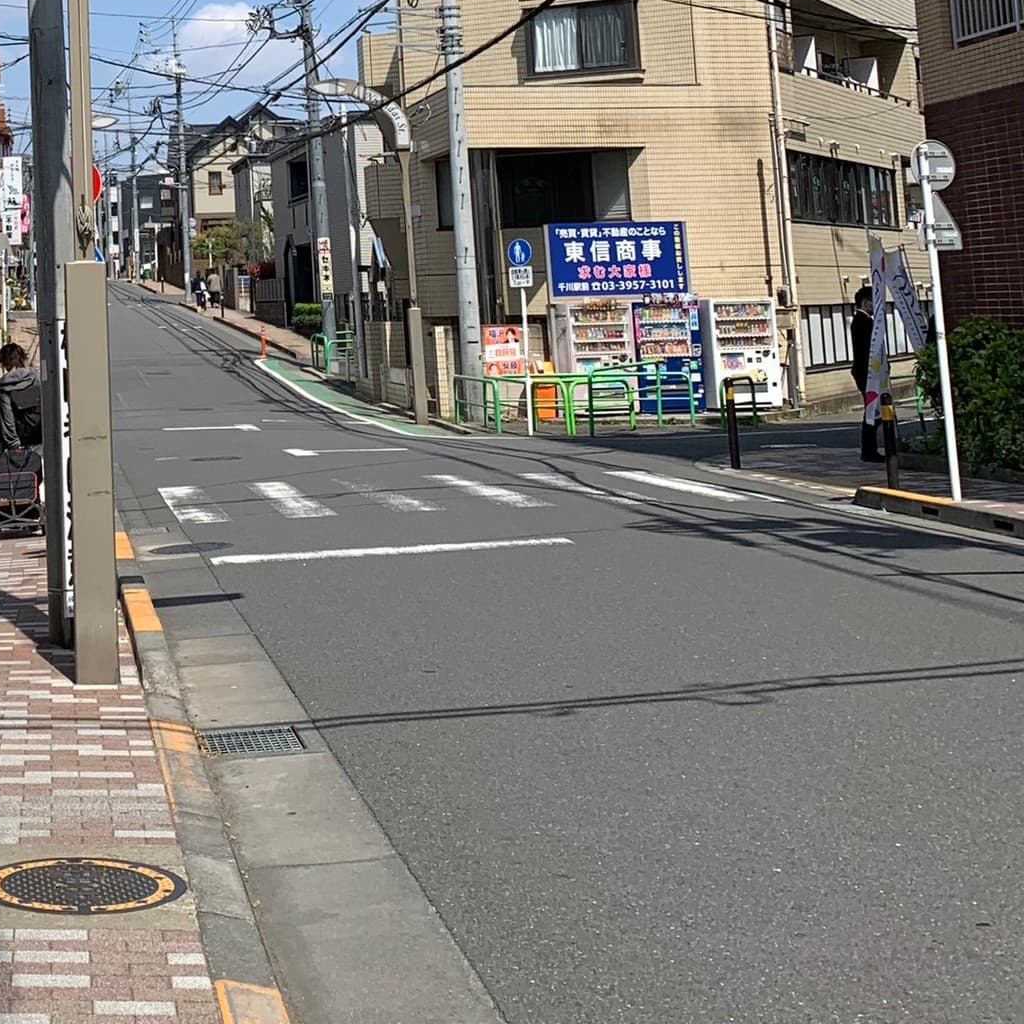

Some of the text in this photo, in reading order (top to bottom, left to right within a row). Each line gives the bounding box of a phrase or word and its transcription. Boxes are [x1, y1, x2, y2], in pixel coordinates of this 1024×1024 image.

[563, 239, 662, 263] 東信商事
[601, 278, 675, 292] 03-3957-3101
